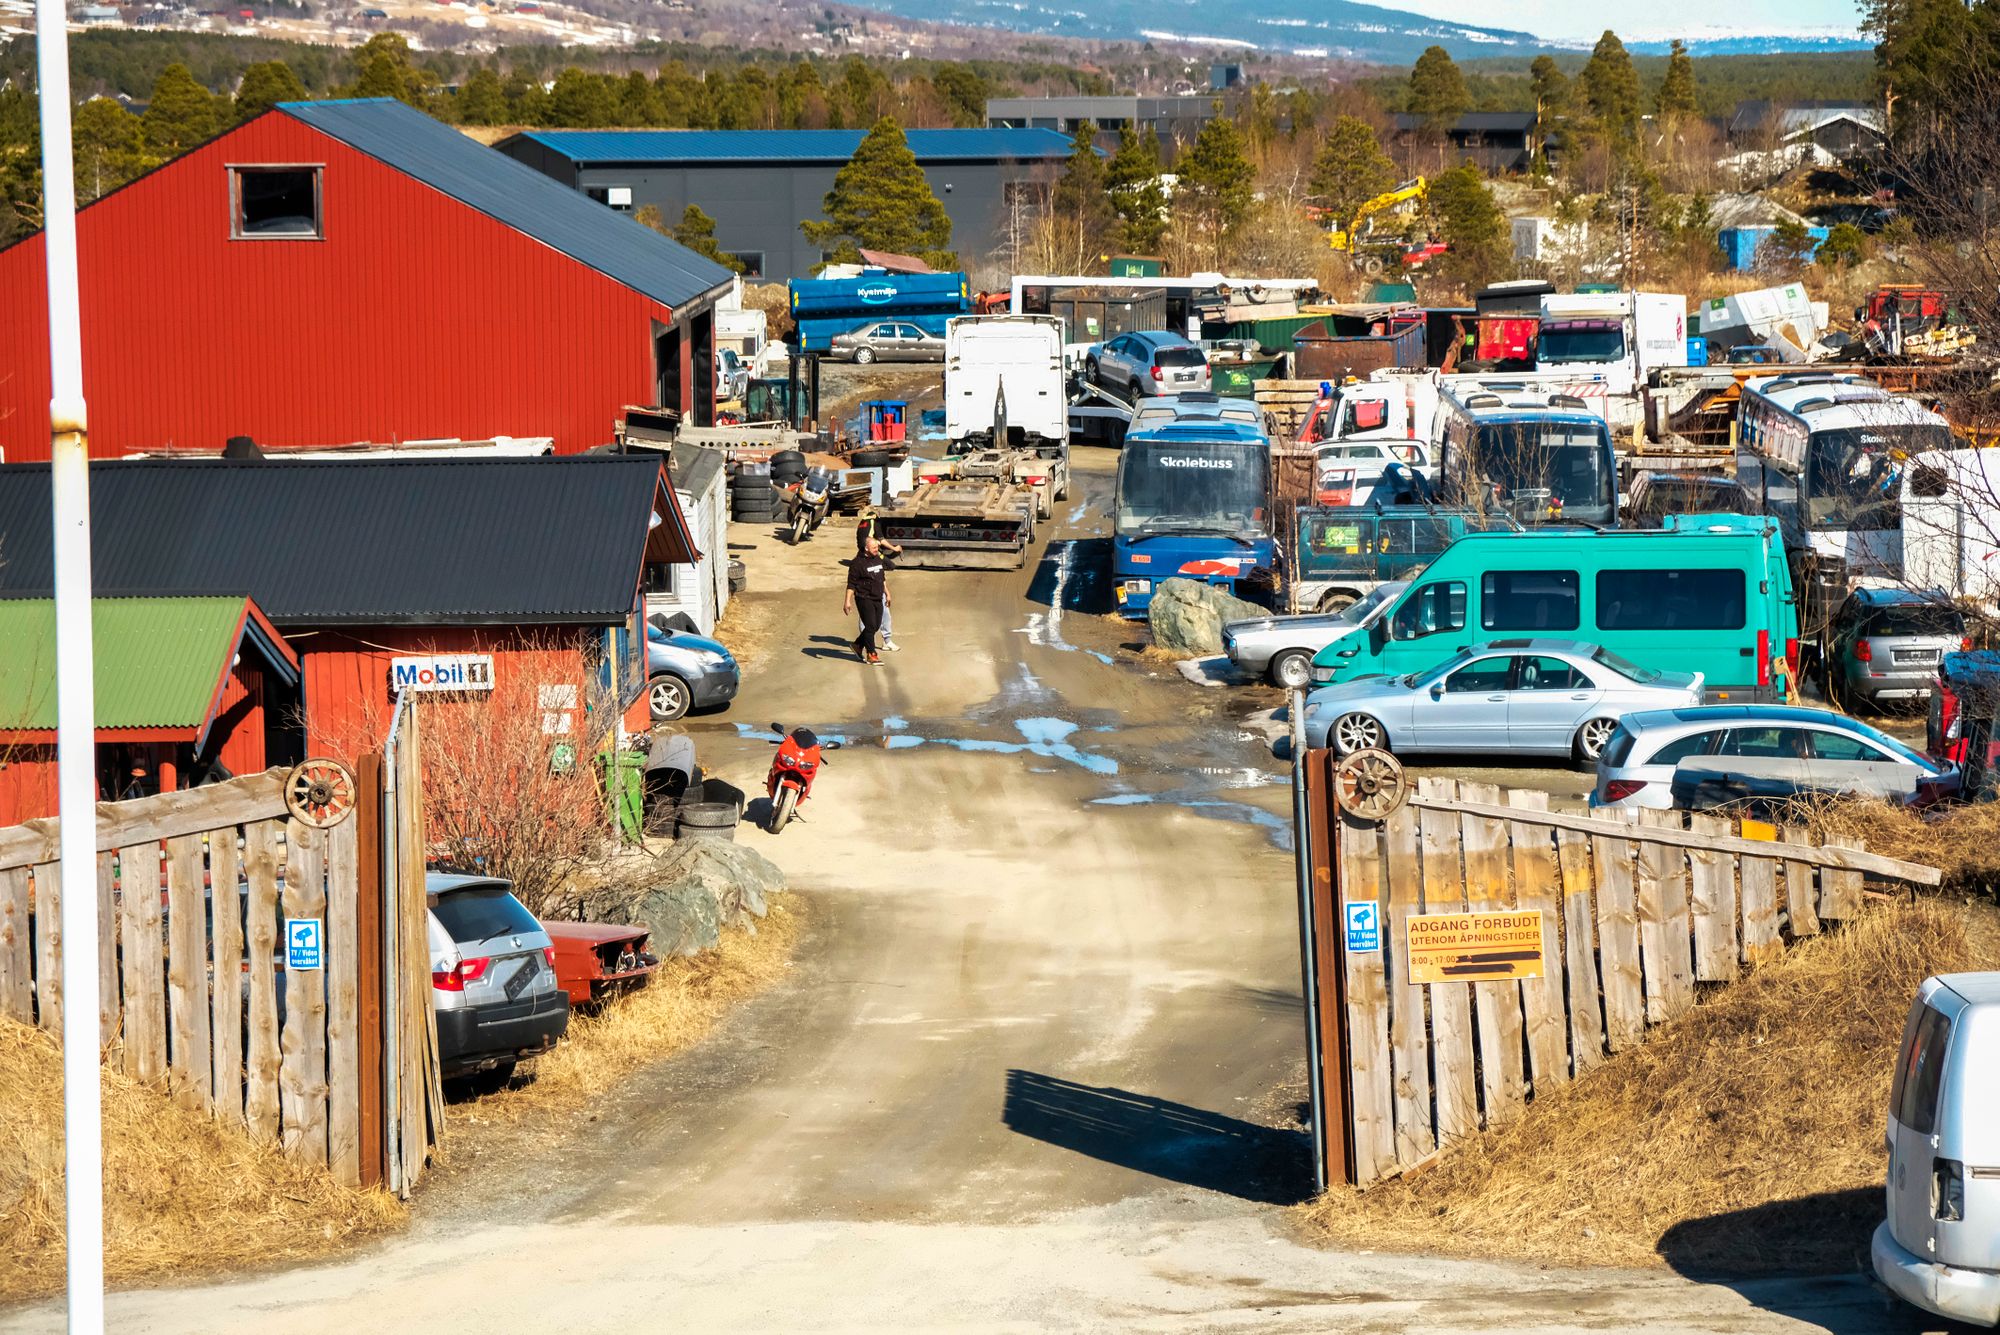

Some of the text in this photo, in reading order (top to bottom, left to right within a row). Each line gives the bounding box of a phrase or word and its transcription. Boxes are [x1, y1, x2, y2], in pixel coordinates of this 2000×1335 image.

[1160, 456, 1233, 469] Skolebuss
[396, 663, 484, 685] Mobil 1
[1410, 917, 1540, 933] ADGANG FORBUDT
[1349, 932, 1357, 940] TV
[1361, 931, 1377, 939] Video
[1411, 931, 1540, 945] UTENOM ÅPNINGSTIDER
[291, 949, 298, 957] TV
[302, 949, 318, 957] Video
[1411, 956, 1428, 965] 8:00
[1435, 955, 1456, 964] 17:00
